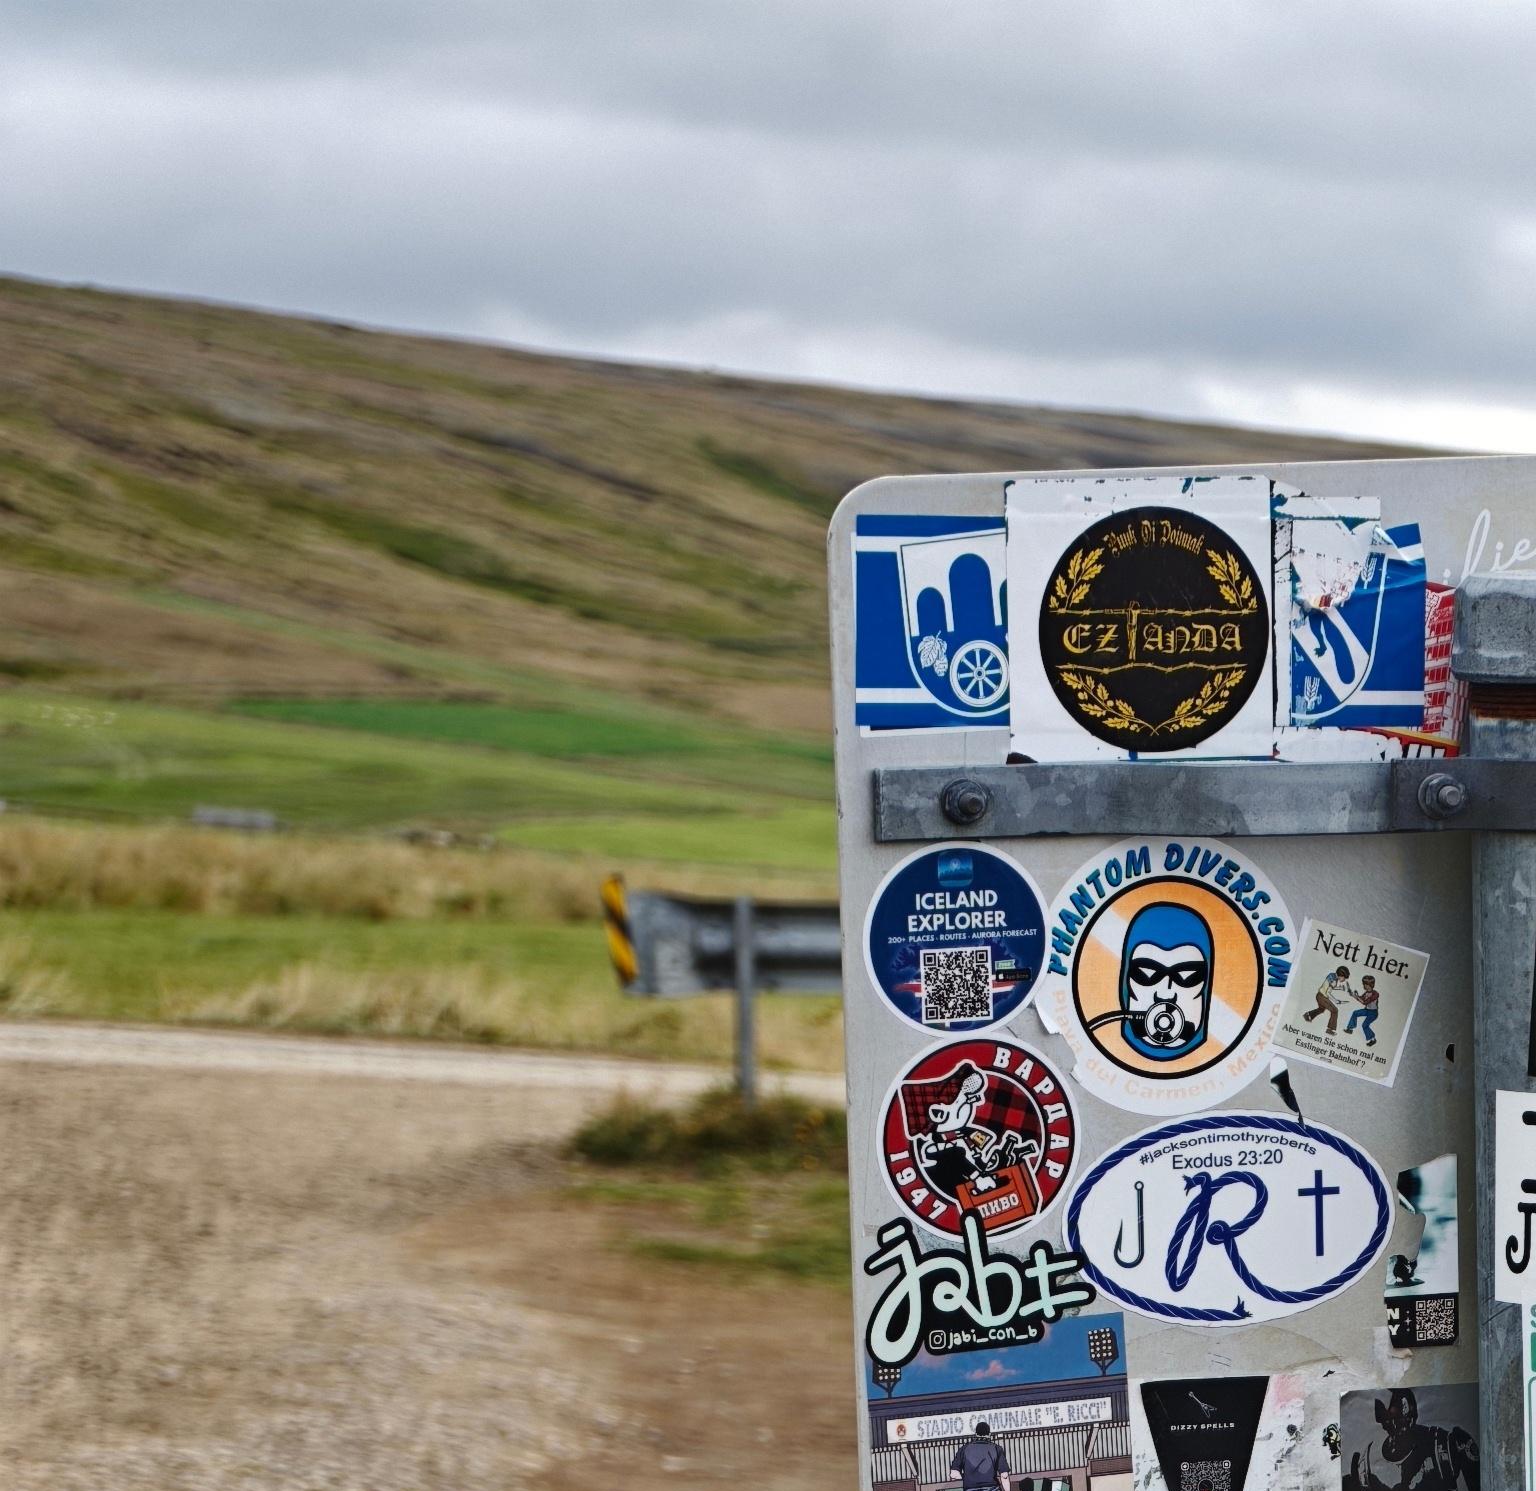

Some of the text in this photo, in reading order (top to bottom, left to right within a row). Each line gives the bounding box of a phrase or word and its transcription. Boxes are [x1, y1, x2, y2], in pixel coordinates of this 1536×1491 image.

[915, 890, 998, 911] ICELAND
[907, 911, 1008, 933] EXPLORER
[1047, 842, 1293, 988] PHANTOM DIVERS.COM
[909, 928, 1038, 943] PLACES ROUTES AURORA FORECAST
[1313, 929, 1410, 980] Nett hier.
[993, 1046, 1071, 1180] ВАРДАР
[1139, 1131, 1318, 1166] #jacksontimothyroberts
[1172, 1148, 1284, 1171] Exodus 23:20
[889, 1151, 949, 1221] 1947
[917, 1417, 964, 1438] STADIO
[1170, 1421, 1236, 1432] DIZZY SPELLS
